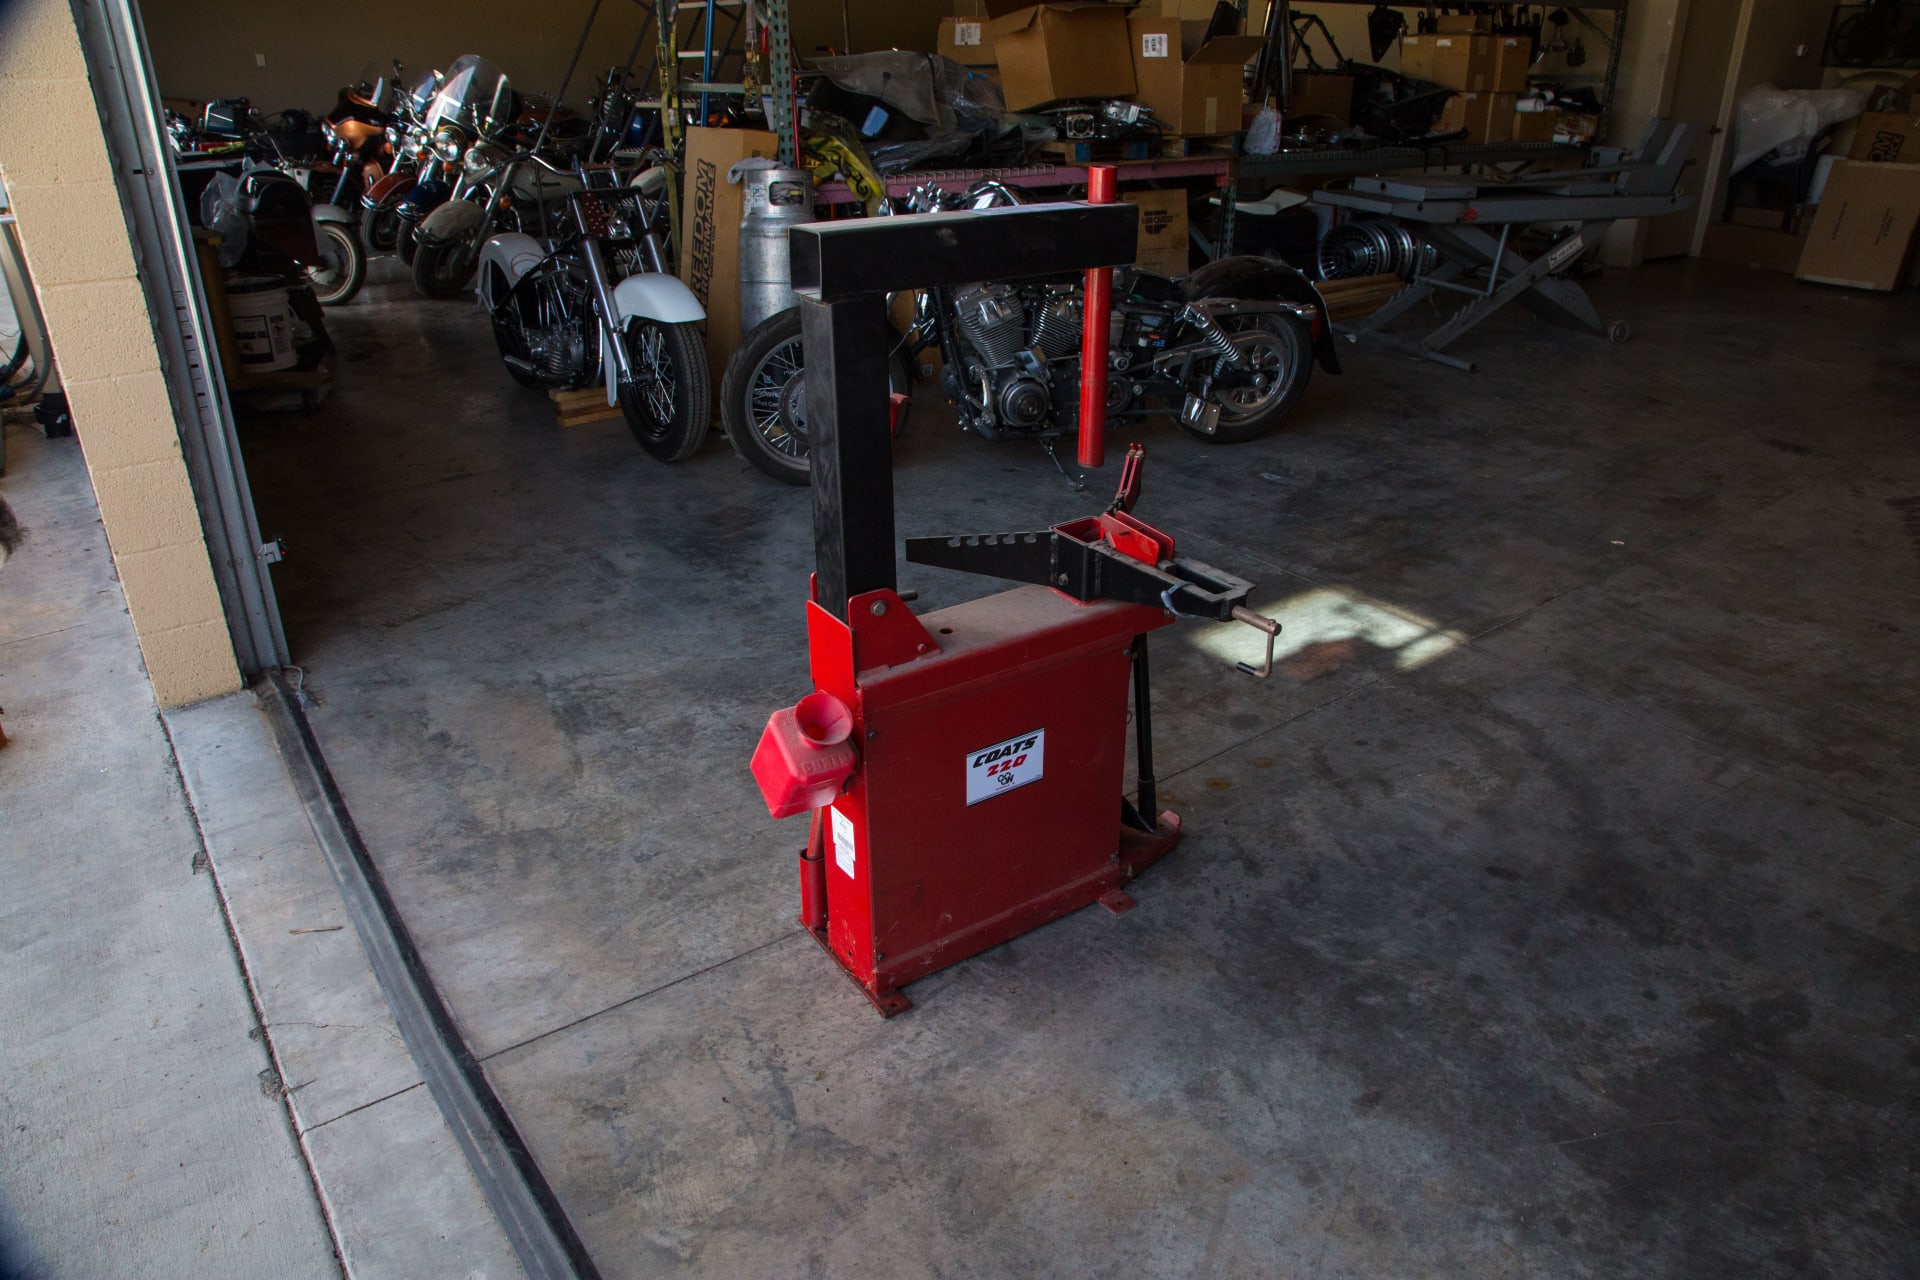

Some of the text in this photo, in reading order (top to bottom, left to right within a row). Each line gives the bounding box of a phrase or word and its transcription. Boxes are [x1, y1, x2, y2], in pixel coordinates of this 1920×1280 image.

[691, 158, 709, 298] REEDOM
[700, 163, 716, 307] ERFORMANCE
[973, 735, 1038, 768] COATS
[987, 754, 1027, 777] 220
